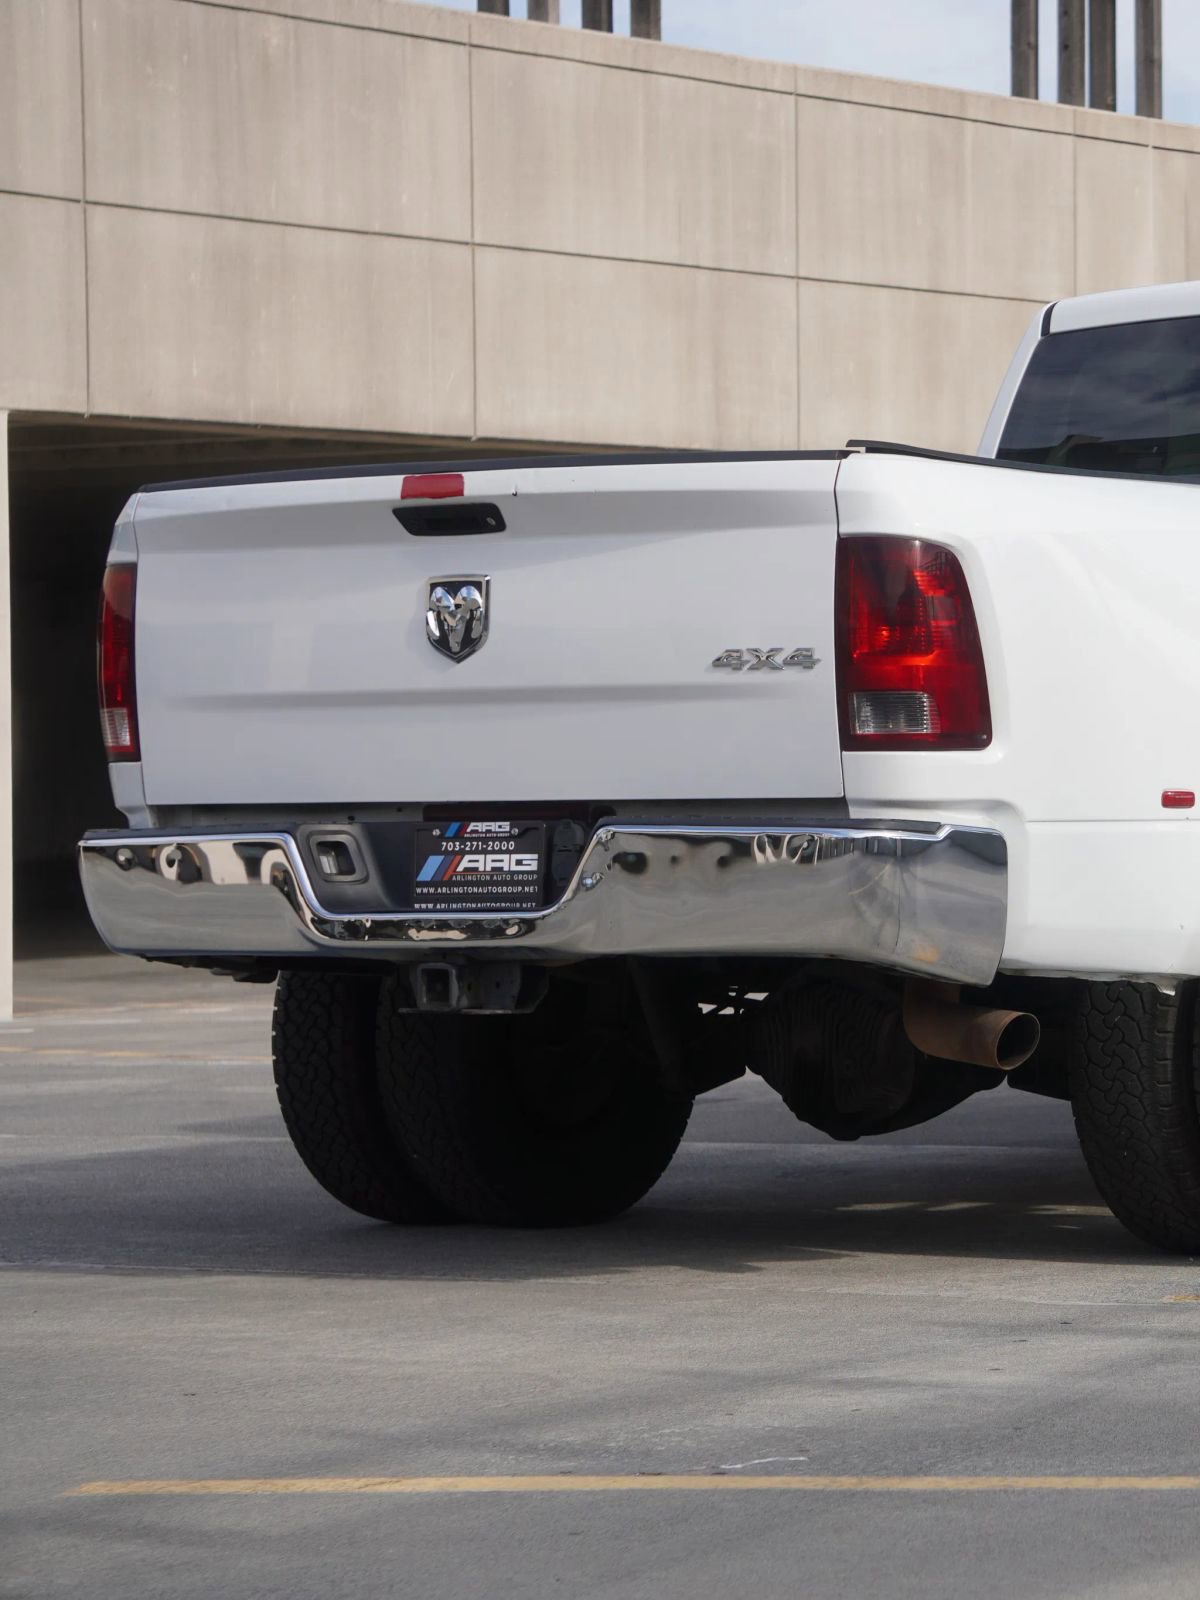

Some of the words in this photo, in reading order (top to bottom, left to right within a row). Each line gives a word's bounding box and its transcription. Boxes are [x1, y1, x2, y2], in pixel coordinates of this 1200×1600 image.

[466, 821, 510, 832] AAG
[441, 841, 515, 851] 703-271-2000
[455, 853, 538, 871] AAG
[416, 886, 538, 894] WWW.ARLINGTONAUTOGROUP.NET
